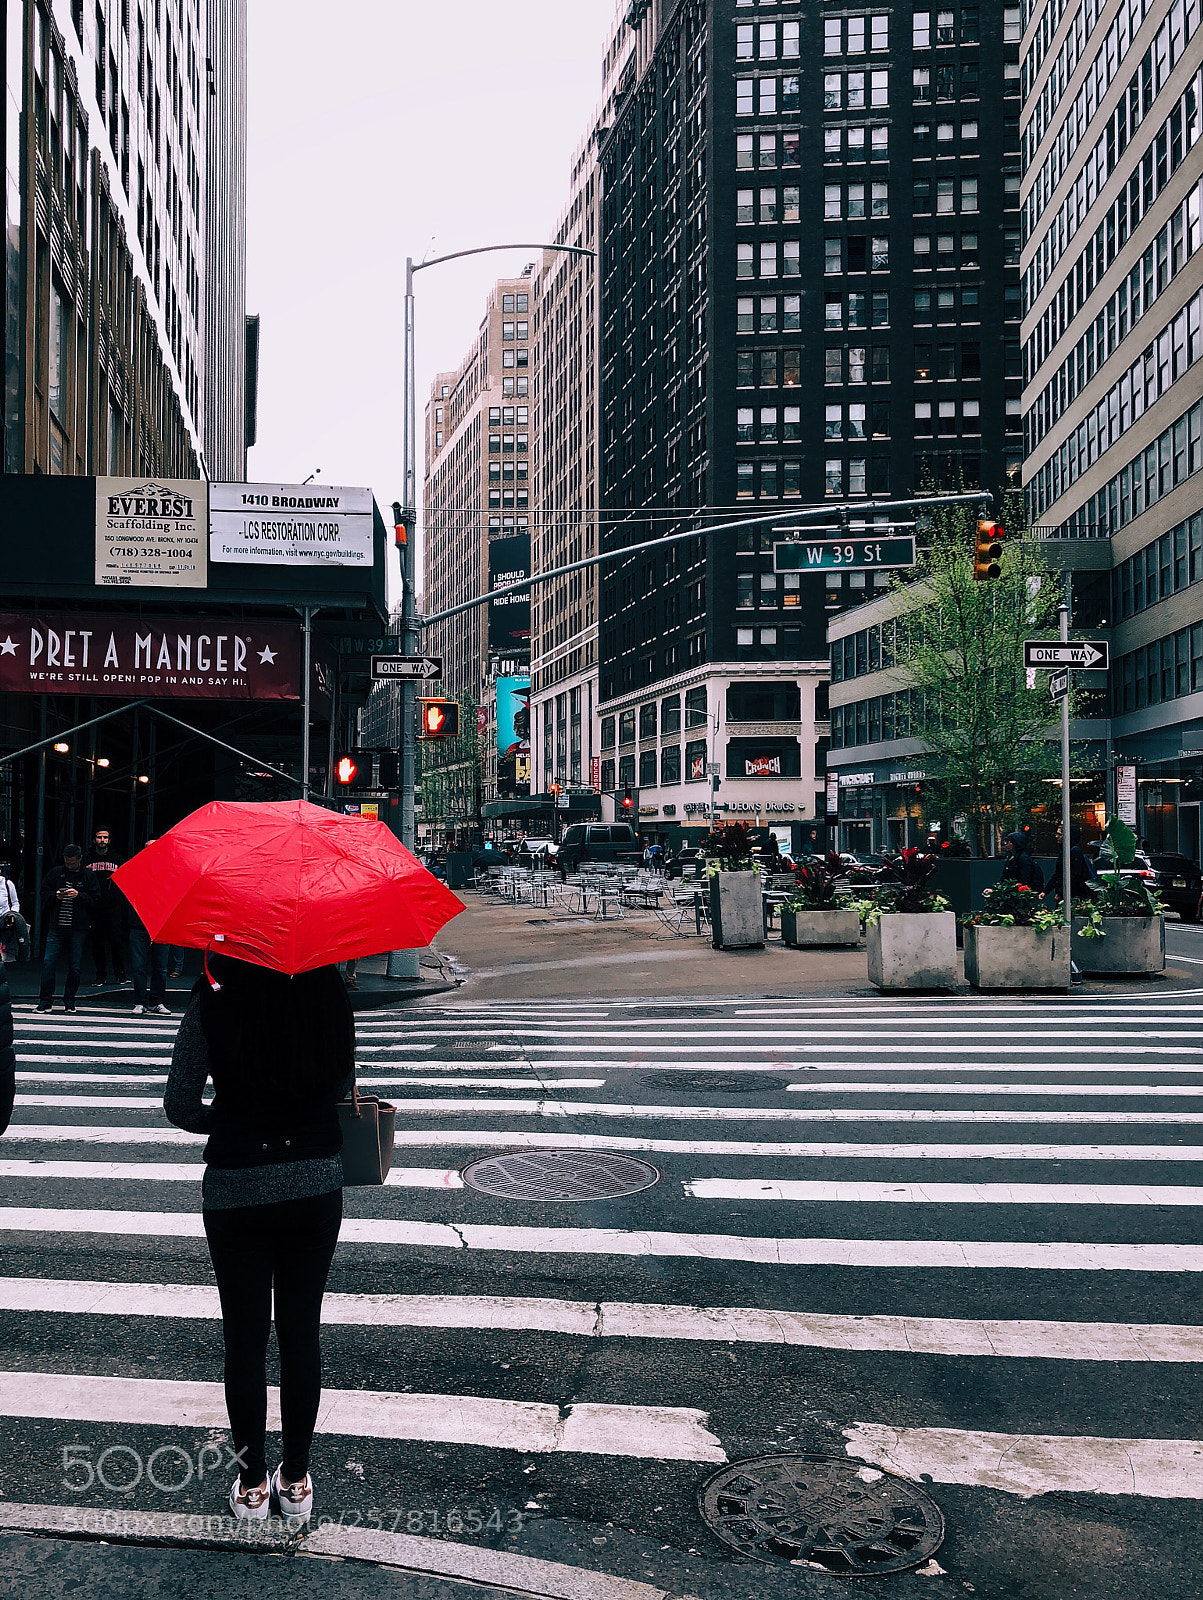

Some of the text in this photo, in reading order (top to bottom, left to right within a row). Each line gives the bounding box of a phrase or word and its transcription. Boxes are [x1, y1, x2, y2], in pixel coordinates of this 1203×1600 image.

[107, 497, 194, 517] EVEREST
[241, 494, 340, 508] 1410 BROADWAY
[106, 519, 196, 533] Scaffolding Inc.
[243, 521, 341, 542] LCS RESTORATION CORP.
[116, 535, 145, 543] LONGWOOD
[109, 547, 193, 558] (718) 328-1004
[222, 545, 233, 554] For
[233, 546, 249, 554] more
[249, 546, 285, 557] information,
[286, 548, 298, 556] visit
[806, 543, 882, 565] W 39 St
[497, 569, 525, 581] SHOULD
[493, 598, 509, 607] RIDE
[30, 628, 247, 672] PRET A MANGER
[367, 639, 384, 653] 39
[1036, 650, 1095, 661] ONE WAY
[382, 663, 432, 673] ONE WAY
[29, 671, 247, 686] WE'RE STILL OPEN! POP IN AND SAY HI.
[745, 756, 781, 776] CRUNCH
[765, 802, 795, 812] DRUGS
